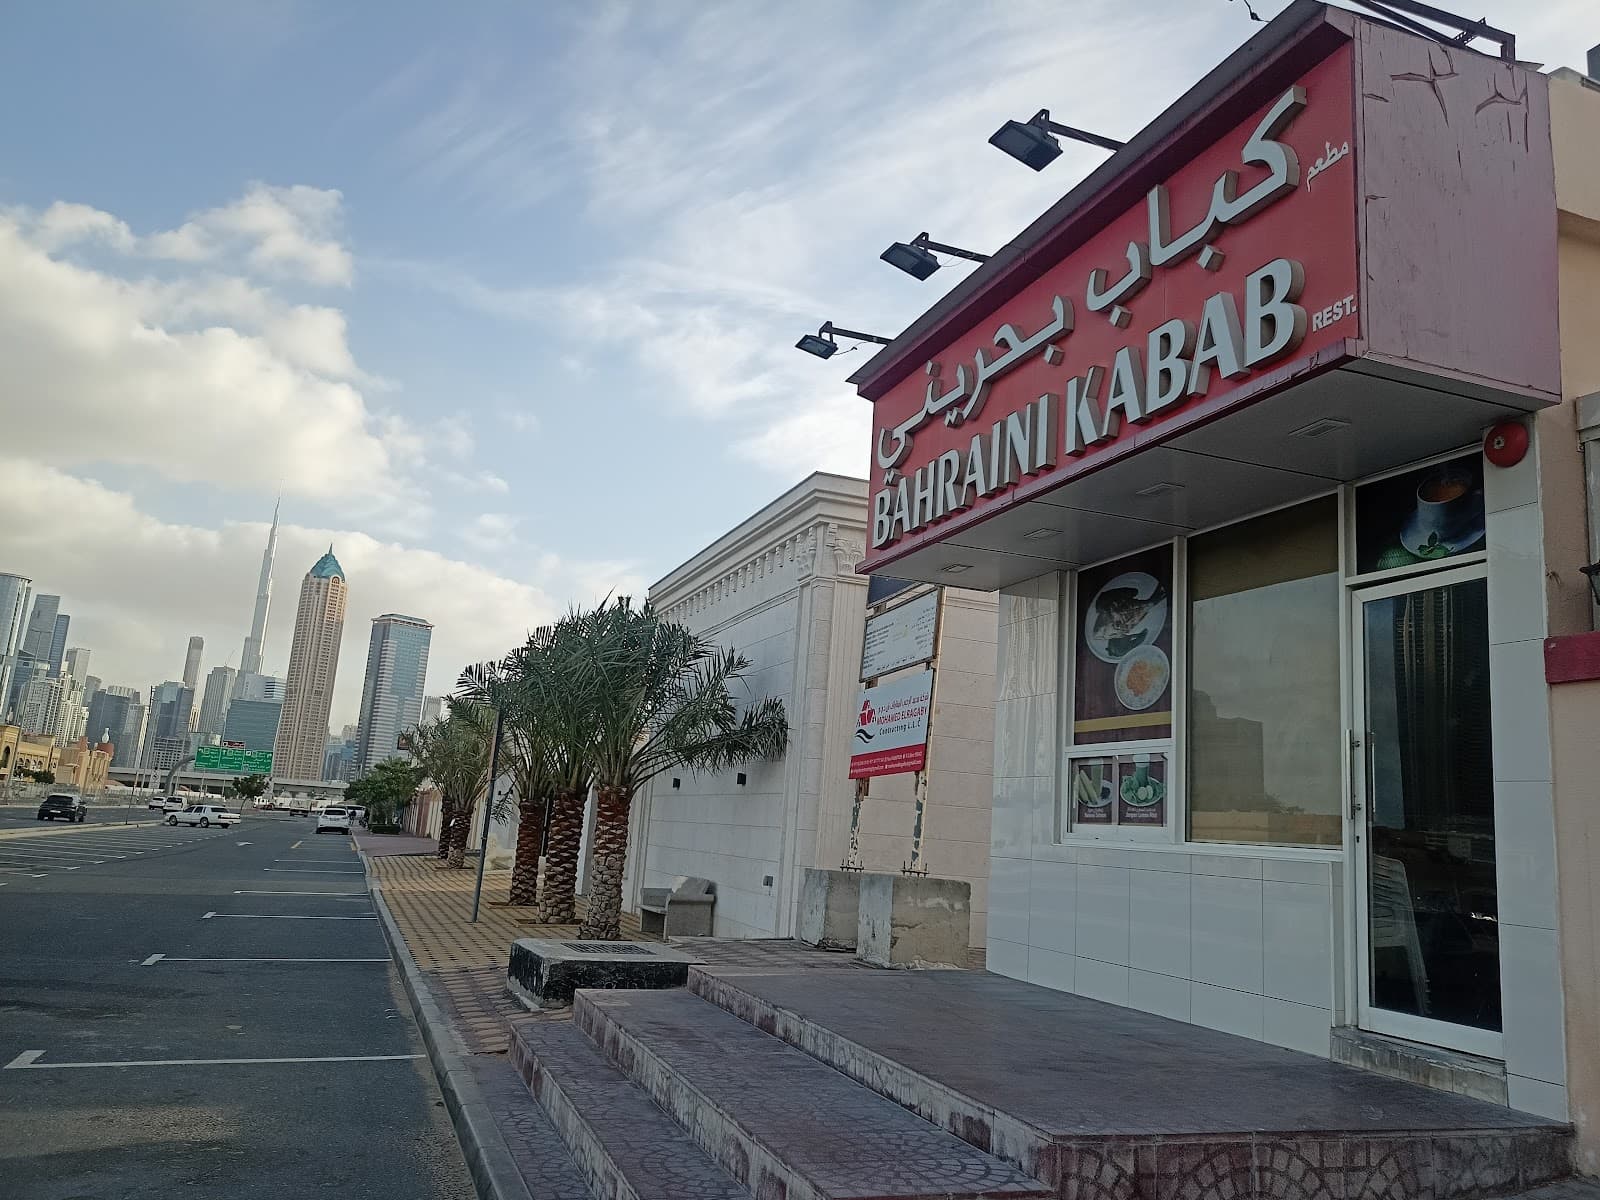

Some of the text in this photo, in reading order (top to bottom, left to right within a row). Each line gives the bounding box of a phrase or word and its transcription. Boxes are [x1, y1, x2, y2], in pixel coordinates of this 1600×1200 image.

[872, 258, 1358, 549] BAHRAINI KABAB REST.
[877, 85, 1349, 486] مطعم كباب بحريني
